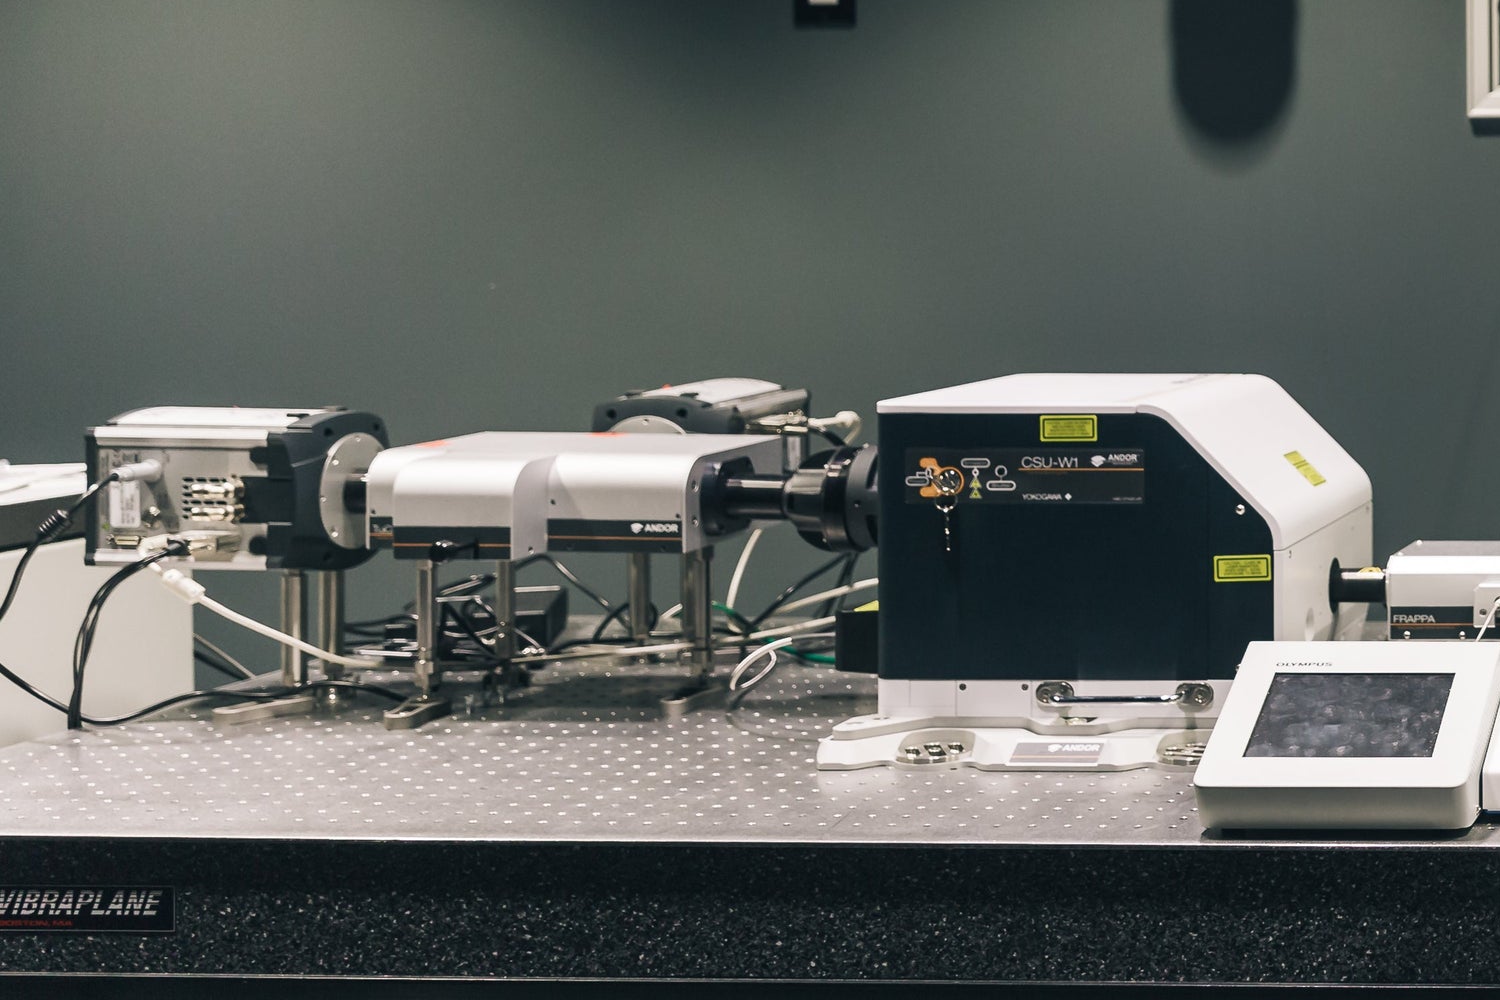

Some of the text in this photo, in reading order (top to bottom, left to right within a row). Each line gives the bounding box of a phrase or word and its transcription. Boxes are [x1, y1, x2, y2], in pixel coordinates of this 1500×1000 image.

[1021, 456, 1078, 468] CSU-W1
[1107, 454, 1138, 462] ANDOR
[1022, 493, 1062, 501] YOKOGAWA
[644, 523, 679, 533] ANDOR
[1393, 614, 1436, 623] FRAPPA
[1062, 744, 1100, 752] ANDOR
[0, 889, 163, 915] VIBRAPLANE
